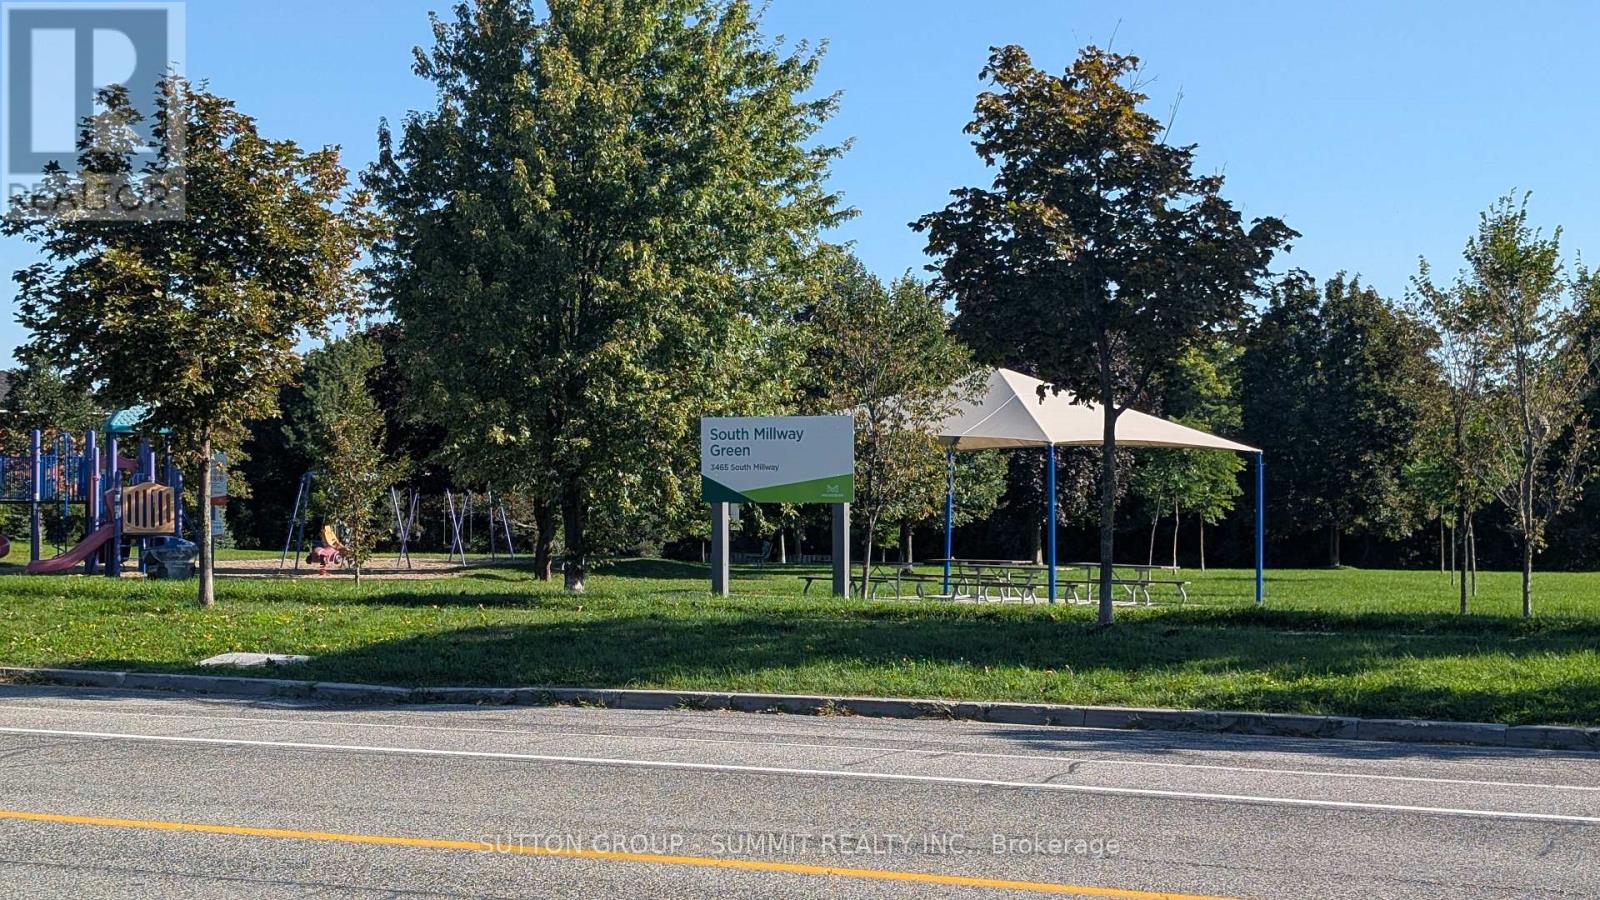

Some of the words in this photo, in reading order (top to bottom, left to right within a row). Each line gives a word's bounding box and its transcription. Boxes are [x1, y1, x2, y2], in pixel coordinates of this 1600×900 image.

[710, 428, 749, 441] South
[754, 427, 804, 442] Millway
[710, 445, 751, 456] Green
[753, 463, 780, 472] Millway
